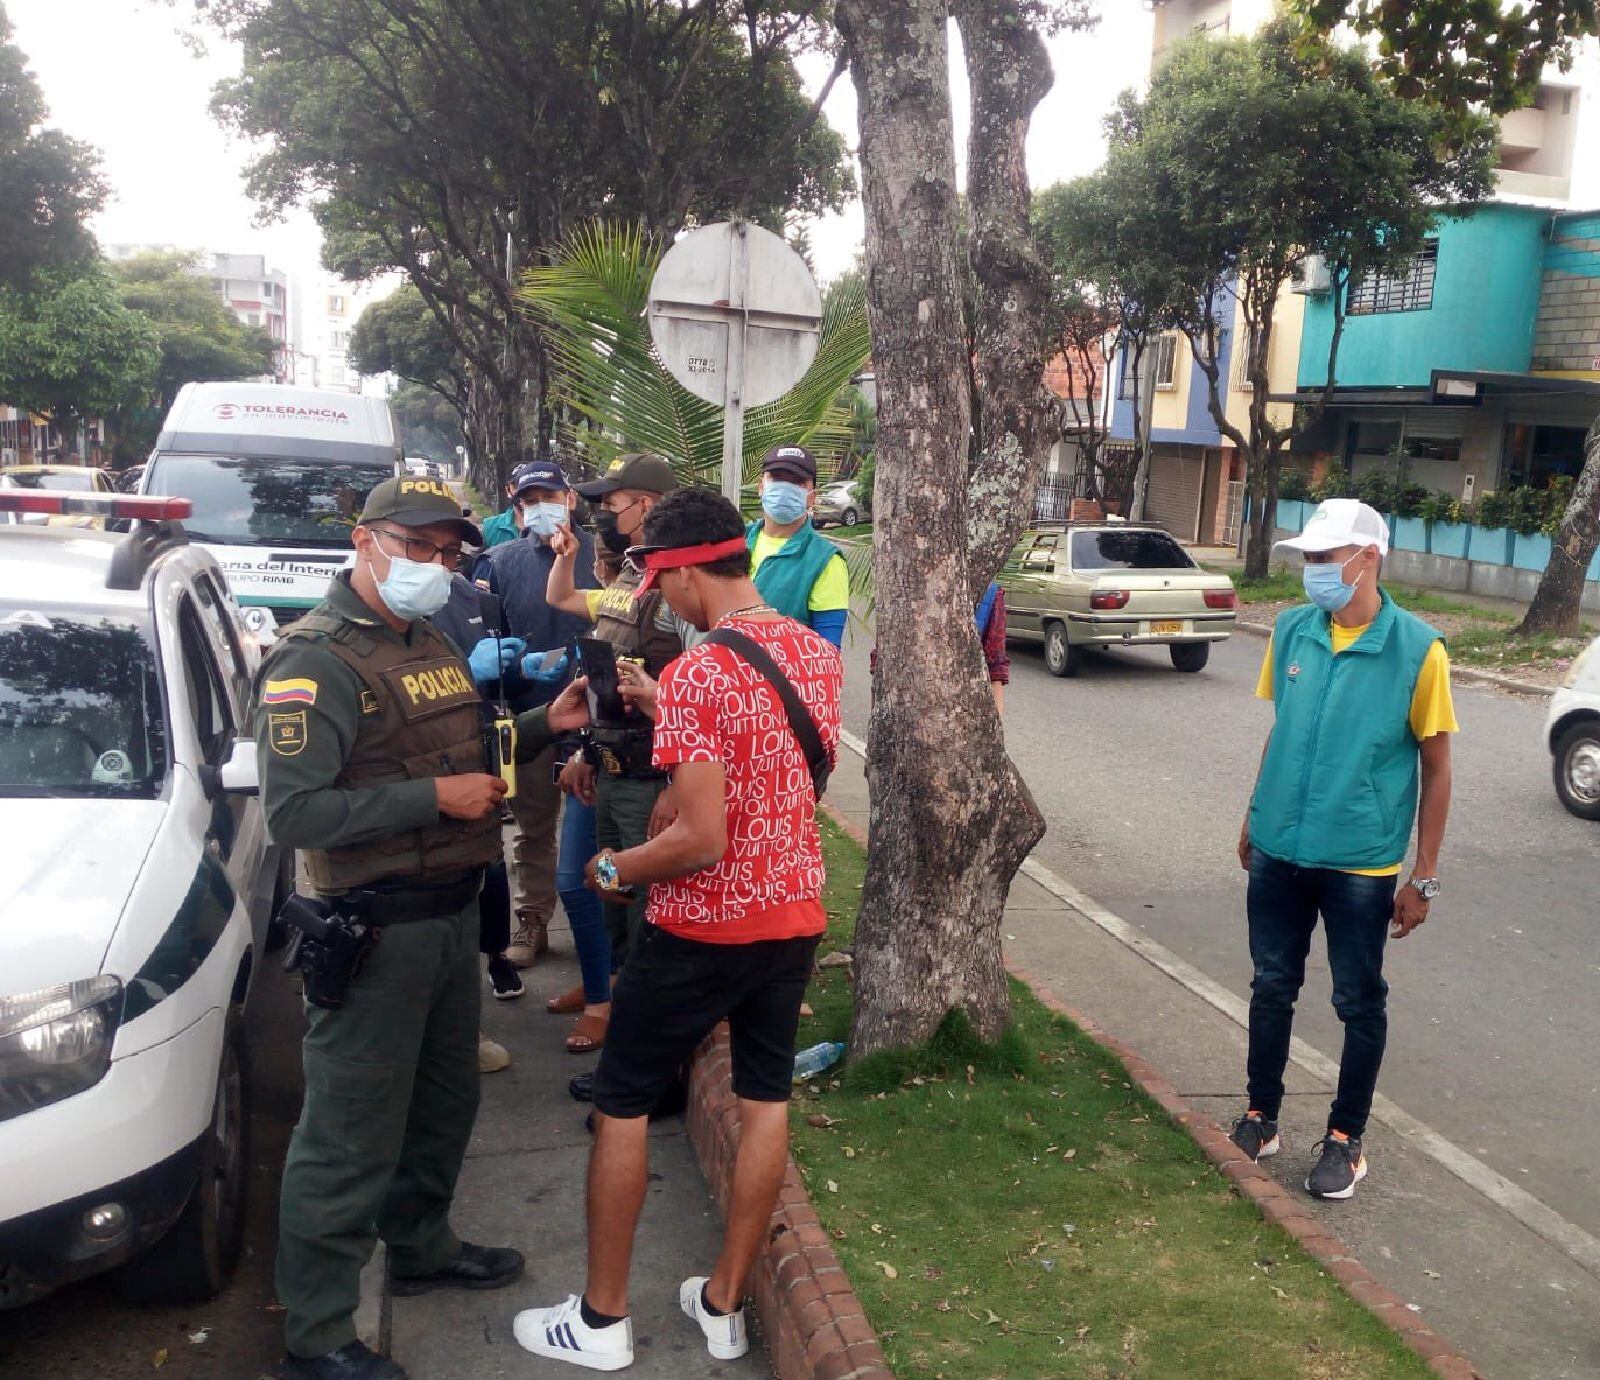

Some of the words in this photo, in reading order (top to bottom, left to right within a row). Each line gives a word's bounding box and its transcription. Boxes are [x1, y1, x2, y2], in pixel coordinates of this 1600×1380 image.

[243, 405, 348, 420] TOLERANCIA
[256, 561, 286, 571] del
[288, 563, 338, 577] Interi
[263, 575, 294, 584] RIMB
[401, 665, 473, 706] POLICIA
[789, 679, 828, 704] OUIS
[654, 704, 700, 730] OUIS
[724, 776, 767, 800] OUIS
[734, 814, 793, 842] LOUIS
